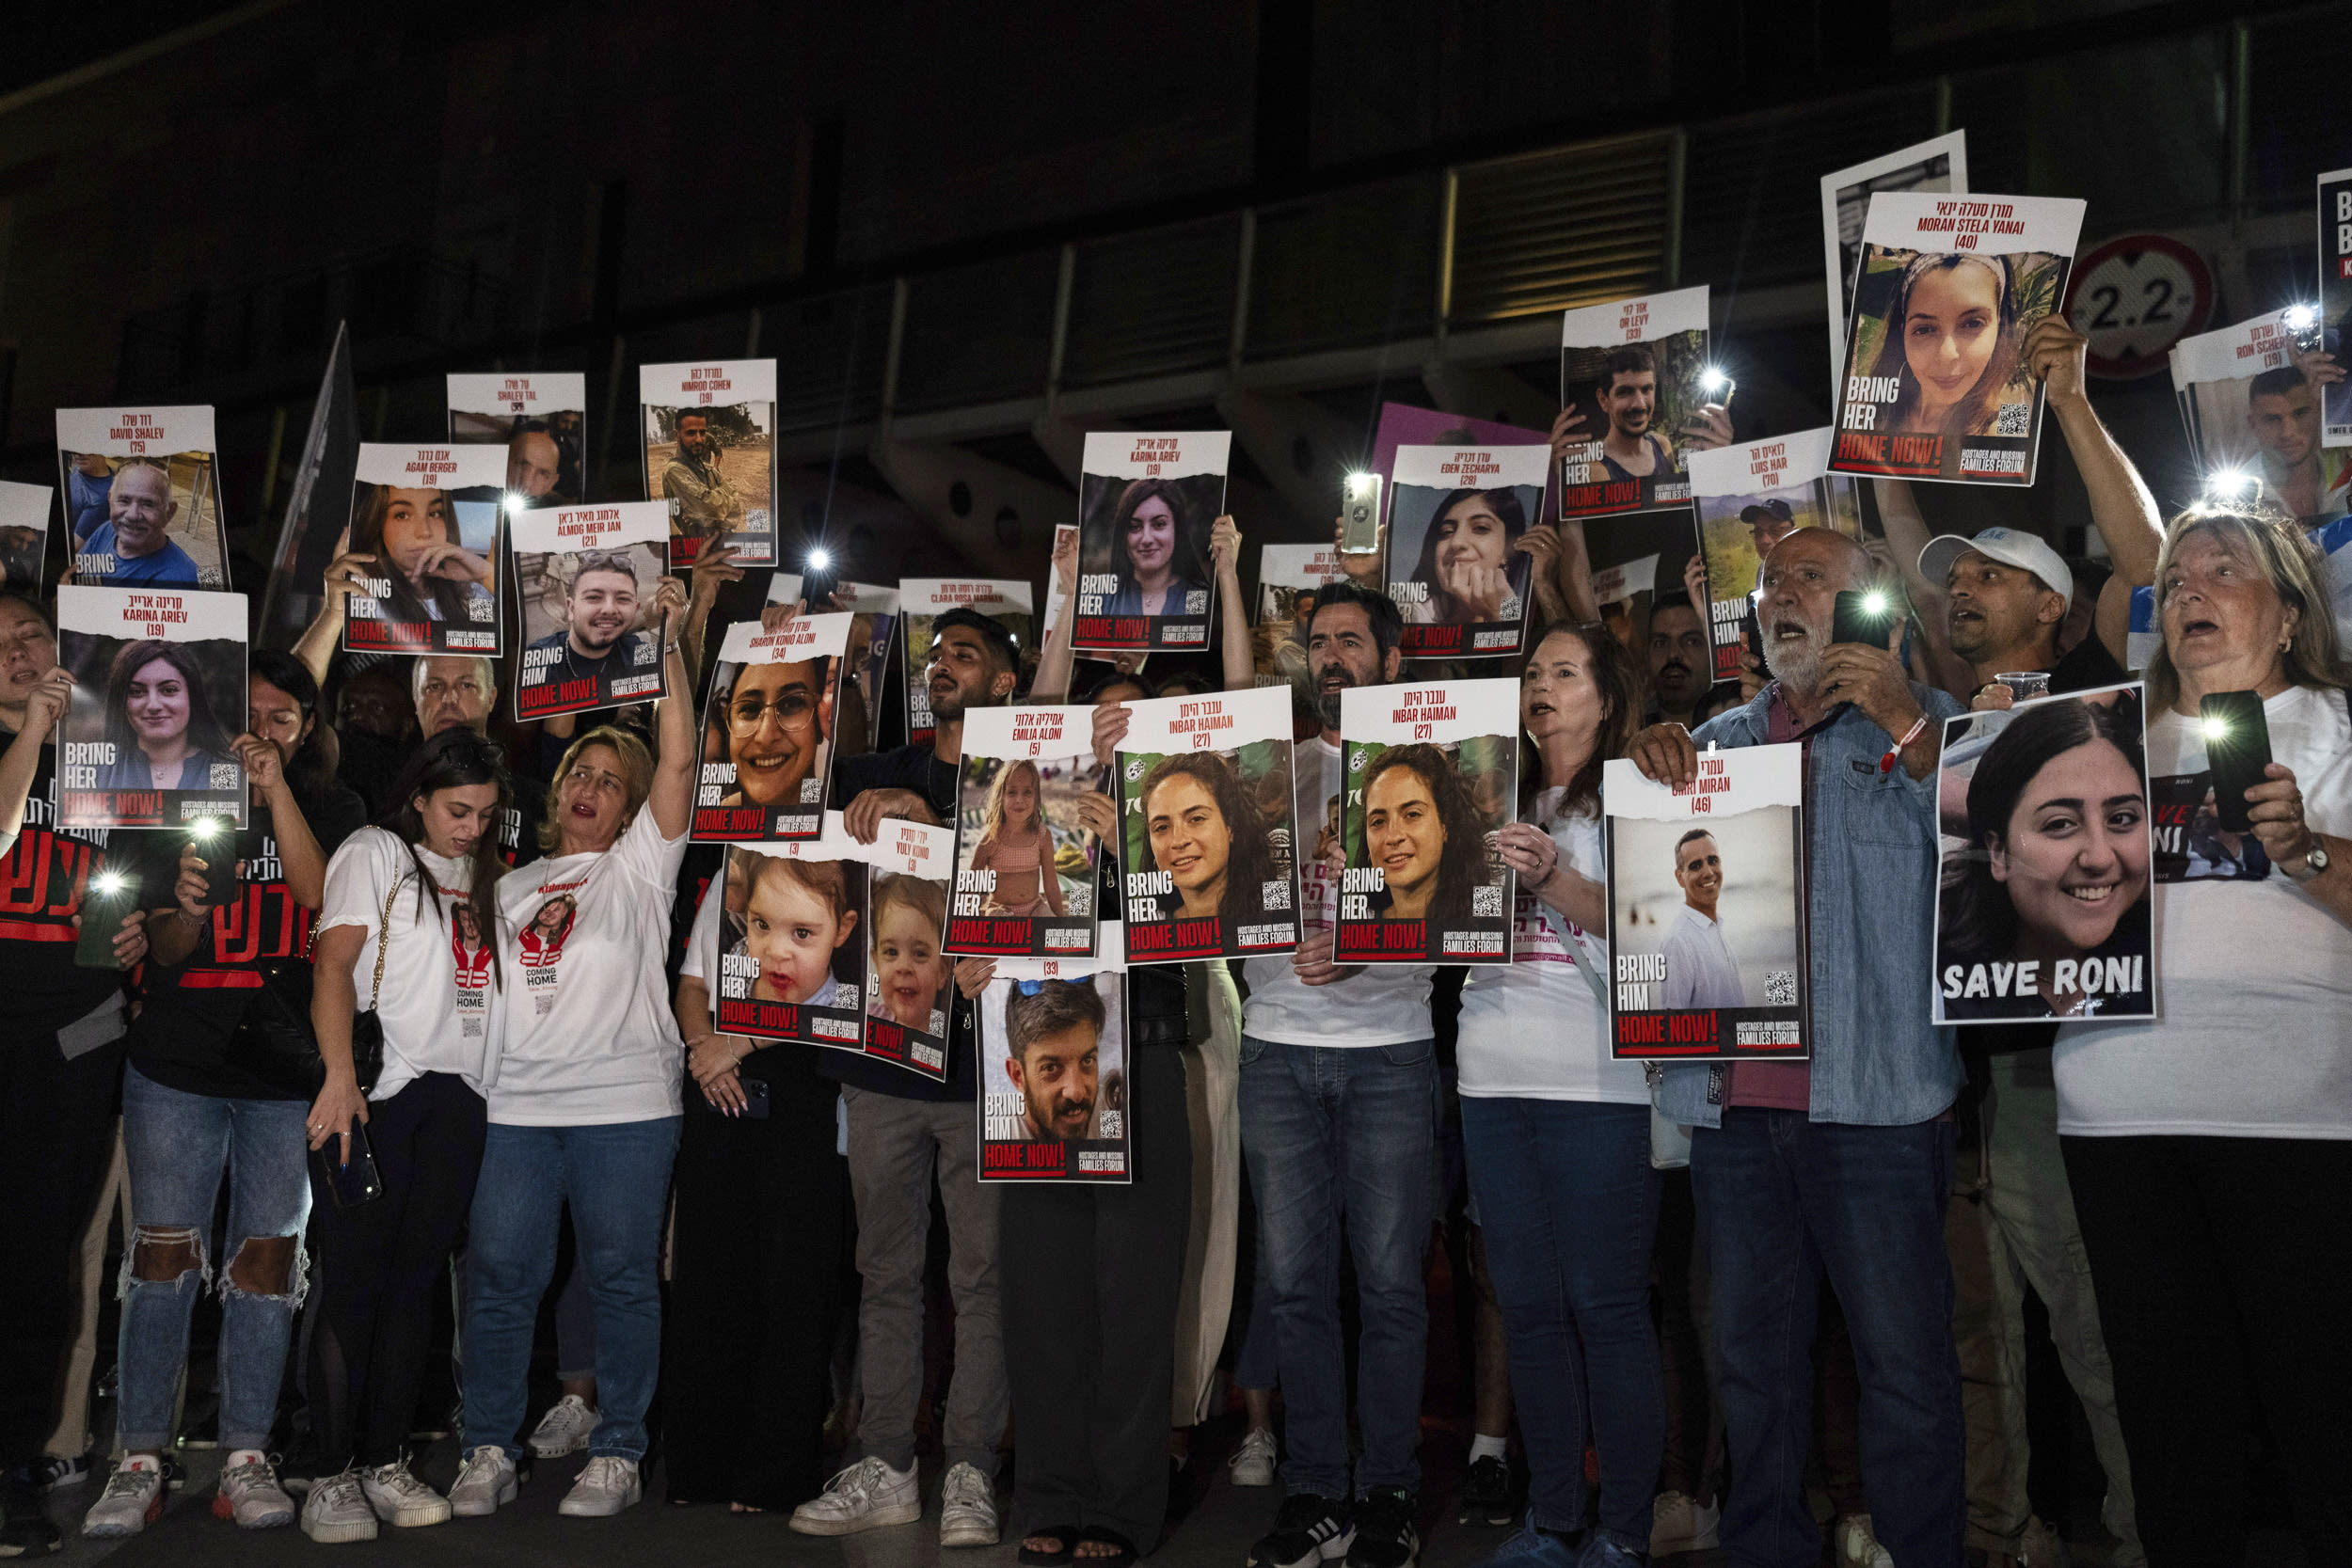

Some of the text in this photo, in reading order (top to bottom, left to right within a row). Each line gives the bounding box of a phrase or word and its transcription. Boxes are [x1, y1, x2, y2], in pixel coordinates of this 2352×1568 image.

[1936, 201, 2013, 218] מורן סטלה ינאי
[1917, 217, 2025, 235] MORAN STELA YANAI
[1954, 233, 1978, 250] (40)
[2089, 278, 2172, 330] 2.2
[1619, 314, 1648, 329] OR LEVY
[2236, 344, 2254, 359] RON
[682, 379, 731, 391] NIMROD COHEN
[1846, 375, 1900, 404] BRING
[498, 390, 537, 402] SHALEV TAL
[1842, 404, 1877, 431] HER
[110, 428, 164, 440] DAVID SHALEV
[130, 441, 146, 454] (75)
[1837, 434, 1944, 466] HOME NOW!
[1130, 451, 1181, 463] KARINA ARIEV
[1751, 457, 1788, 474] LUIS HAR
[1960, 458, 2025, 474] FAMILIES FORUM
[405, 462, 457, 473] AGAM BERGER
[1146, 463, 1161, 477] (19)
[1440, 464, 1501, 475] EDEN ZECHARYA
[1565, 464, 1590, 485] HER
[422, 473, 437, 486] (19)
[1459, 474, 1477, 487] (28)
[1762, 472, 1779, 488] (70)
[1566, 478, 1641, 507] HOME NOW!
[557, 521, 621, 537] ALMOG MEIR JAN
[581, 534, 597, 548] (21)
[75, 553, 116, 574] BRING
[1081, 574, 1118, 594] BRING
[1389, 581, 1428, 603] BRING
[128, 594, 183, 610] קרינה ארייב
[931, 594, 953, 603] CLARA
[1078, 594, 1103, 616] HER
[123, 609, 188, 624] KARINA ARIEV
[350, 597, 376, 619] HER
[147, 623, 165, 638] (19)
[349, 621, 432, 643] HOME NOW!
[1076, 616, 1150, 639] HOME NOW!
[1425, 625, 1462, 646] NOW!
[1713, 621, 1740, 646] HIM
[446, 637, 496, 649] FAMILIES FORUM
[750, 637, 775, 648] SHARON
[796, 633, 816, 644] ALONI
[523, 646, 564, 669] BRING
[771, 647, 786, 660] (34)
[521, 667, 548, 688] HIM
[520, 674, 597, 709] HOME NOW!
[1403, 689, 1446, 707] ענבר הימן
[1180, 700, 1222, 719] ענבר הימן
[1392, 706, 1456, 723] INBAR HAIMAN
[912, 711, 934, 729] HER
[1015, 713, 1064, 729] אמיליה אלוני
[1169, 715, 1233, 734] INBAR HAIMAN
[1012, 727, 1062, 741] EMILIA ALONI
[1414, 722, 1432, 739] (27)
[1028, 742, 1041, 757] (5)
[1193, 733, 1211, 749] (27)
[65, 742, 116, 766] BRING
[701, 763, 737, 784] BRING
[1700, 759, 1724, 775] עמרי
[64, 766, 97, 790] HER
[1698, 776, 1730, 795] MIRAN
[63, 791, 163, 816] HOME NOW!
[698, 785, 723, 807] HER
[1692, 796, 1711, 816] (46)
[694, 806, 766, 831] HOME NOW!
[897, 841, 912, 856] YULY
[908, 857, 916, 873] (3)
[957, 869, 997, 894] BRING
[1127, 870, 1173, 897] BRING
[1343, 866, 1385, 893] BRING
[953, 894, 981, 917] HER
[1128, 897, 1158, 923] HER
[1341, 895, 1368, 920] HER
[950, 918, 1032, 944] HOME NOW!
[1129, 917, 1221, 951] HOME NOW!
[1237, 923, 1295, 936] HOSTAGES AND MISSING
[1238, 930, 1295, 947] FAMILIES FORUM
[1340, 919, 1426, 949] HOME NOW!
[1443, 931, 1503, 942] HOSTAGES AND MISSING
[1443, 940, 1503, 954] FAMILIES FORUM
[526, 967, 557, 977] COMING
[723, 953, 760, 979] BRING
[1043, 960, 1058, 976] (33)
[1616, 953, 1666, 983] BRING
[527, 974, 558, 987] HOME
[1943, 955, 2143, 1000] SAVE RONI
[457, 990, 484, 999] COMING
[722, 975, 746, 1000] HER
[456, 998, 484, 1008] HOME
[1616, 983, 1649, 1012] HIM
[721, 1000, 798, 1030] HOME NOW!
[1618, 1010, 1718, 1044] HOME NOW!
[1736, 1021, 1799, 1033] HOSTAGES AND MISSING
[874, 1022, 904, 1053] NOW!
[1737, 1030, 1800, 1046] FAMILIES FORUM
[984, 1091, 1025, 1117] BRING
[984, 1116, 1012, 1140] HIM
[984, 1141, 1065, 1167] HOME NOW!
[1078, 1159, 1124, 1172] FAMILIES FORUM
